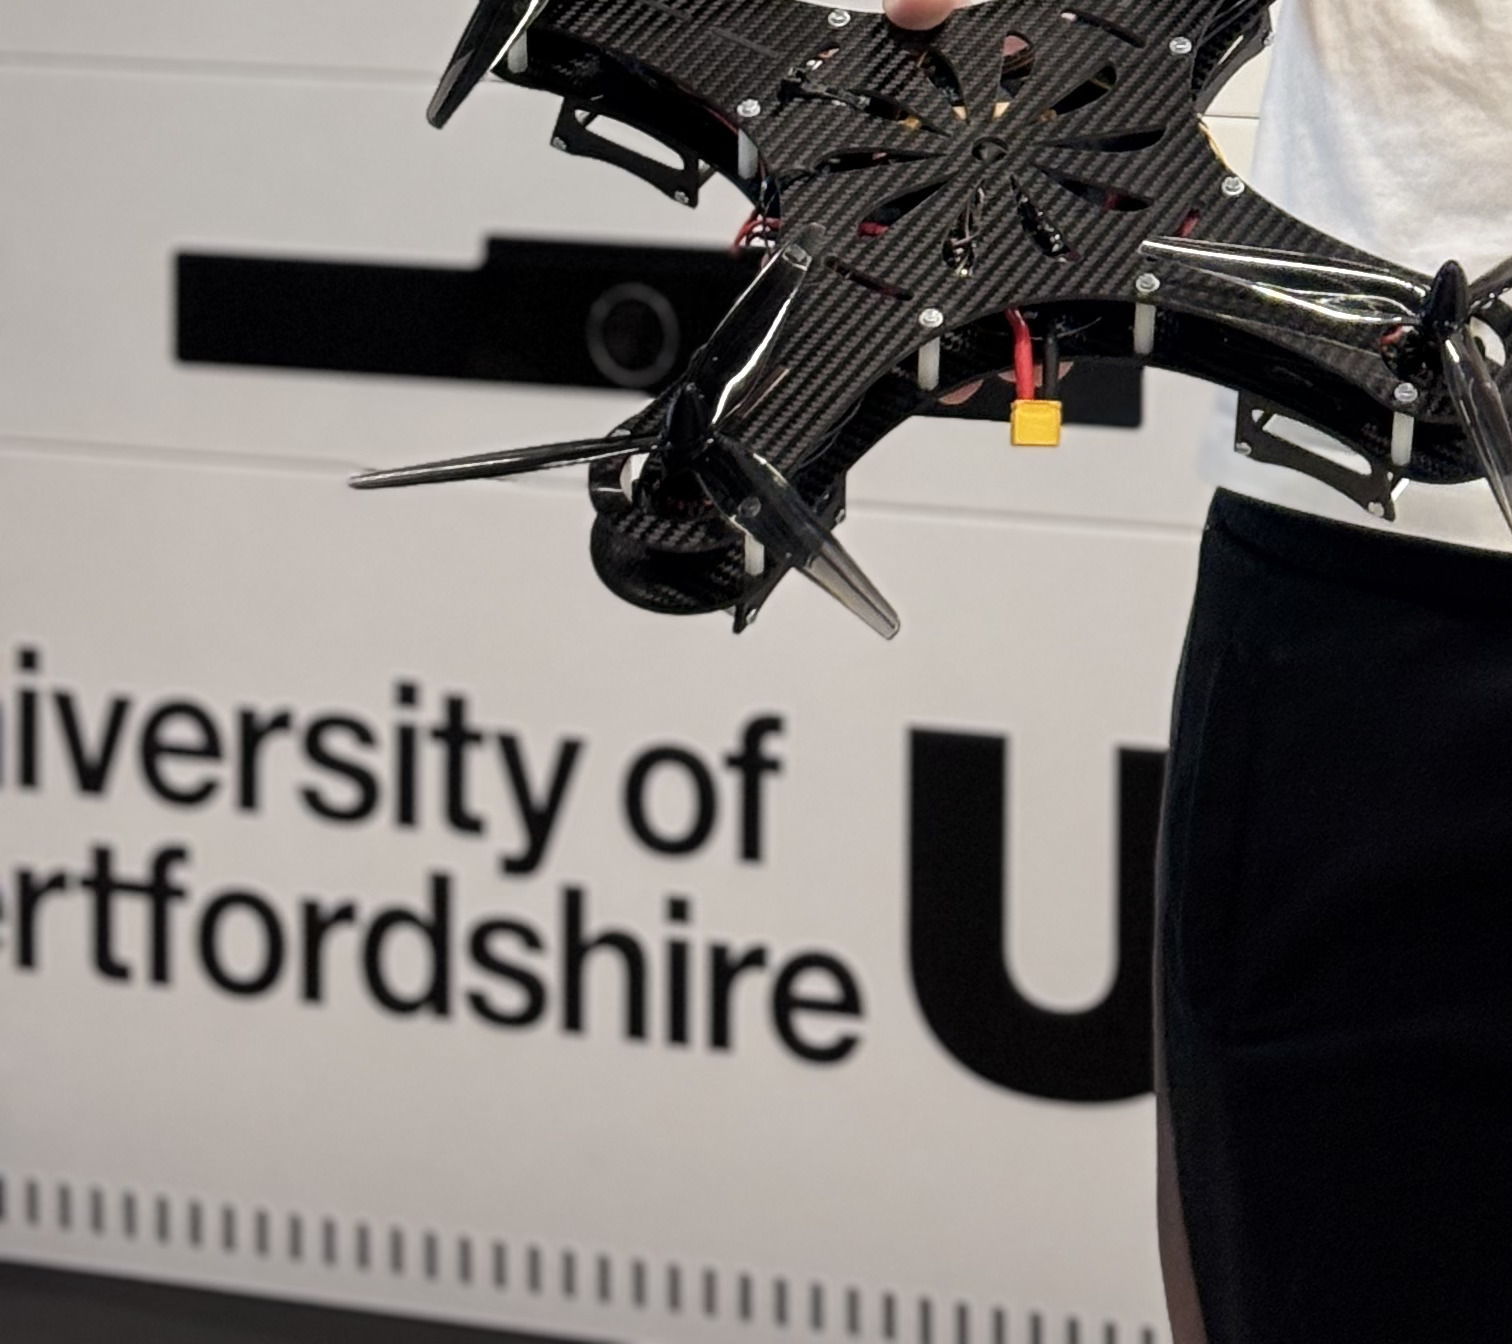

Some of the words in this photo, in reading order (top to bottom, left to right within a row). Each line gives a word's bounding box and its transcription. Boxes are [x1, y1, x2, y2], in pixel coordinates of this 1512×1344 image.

[0, 647, 586, 879] iversity
[621, 714, 786, 865] of
[0, 843, 867, 1068] rtfordshire
[907, 726, 1167, 1108] U
